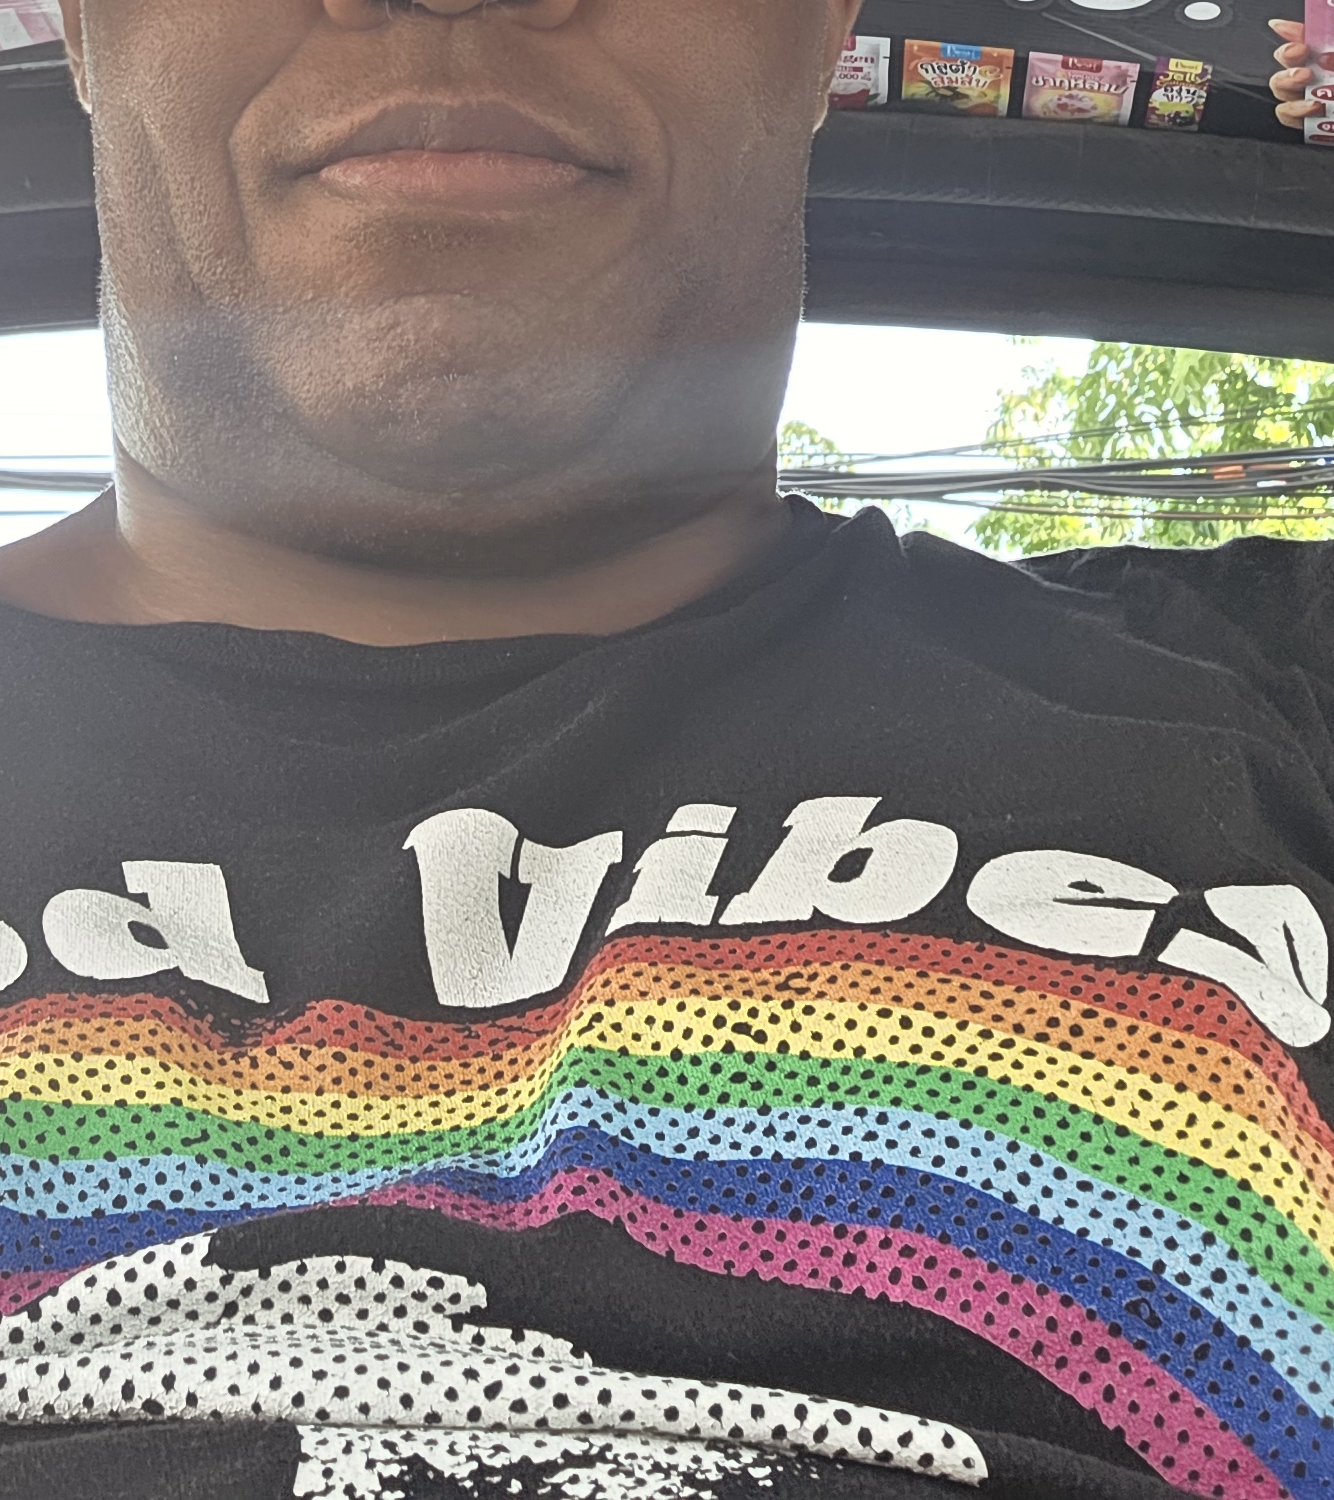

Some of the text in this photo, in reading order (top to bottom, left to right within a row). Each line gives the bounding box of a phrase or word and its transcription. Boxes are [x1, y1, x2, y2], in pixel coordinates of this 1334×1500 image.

[1031, 75, 1129, 95] ชากุหลาบ
[402, 796, 1332, 1048] Vibes
